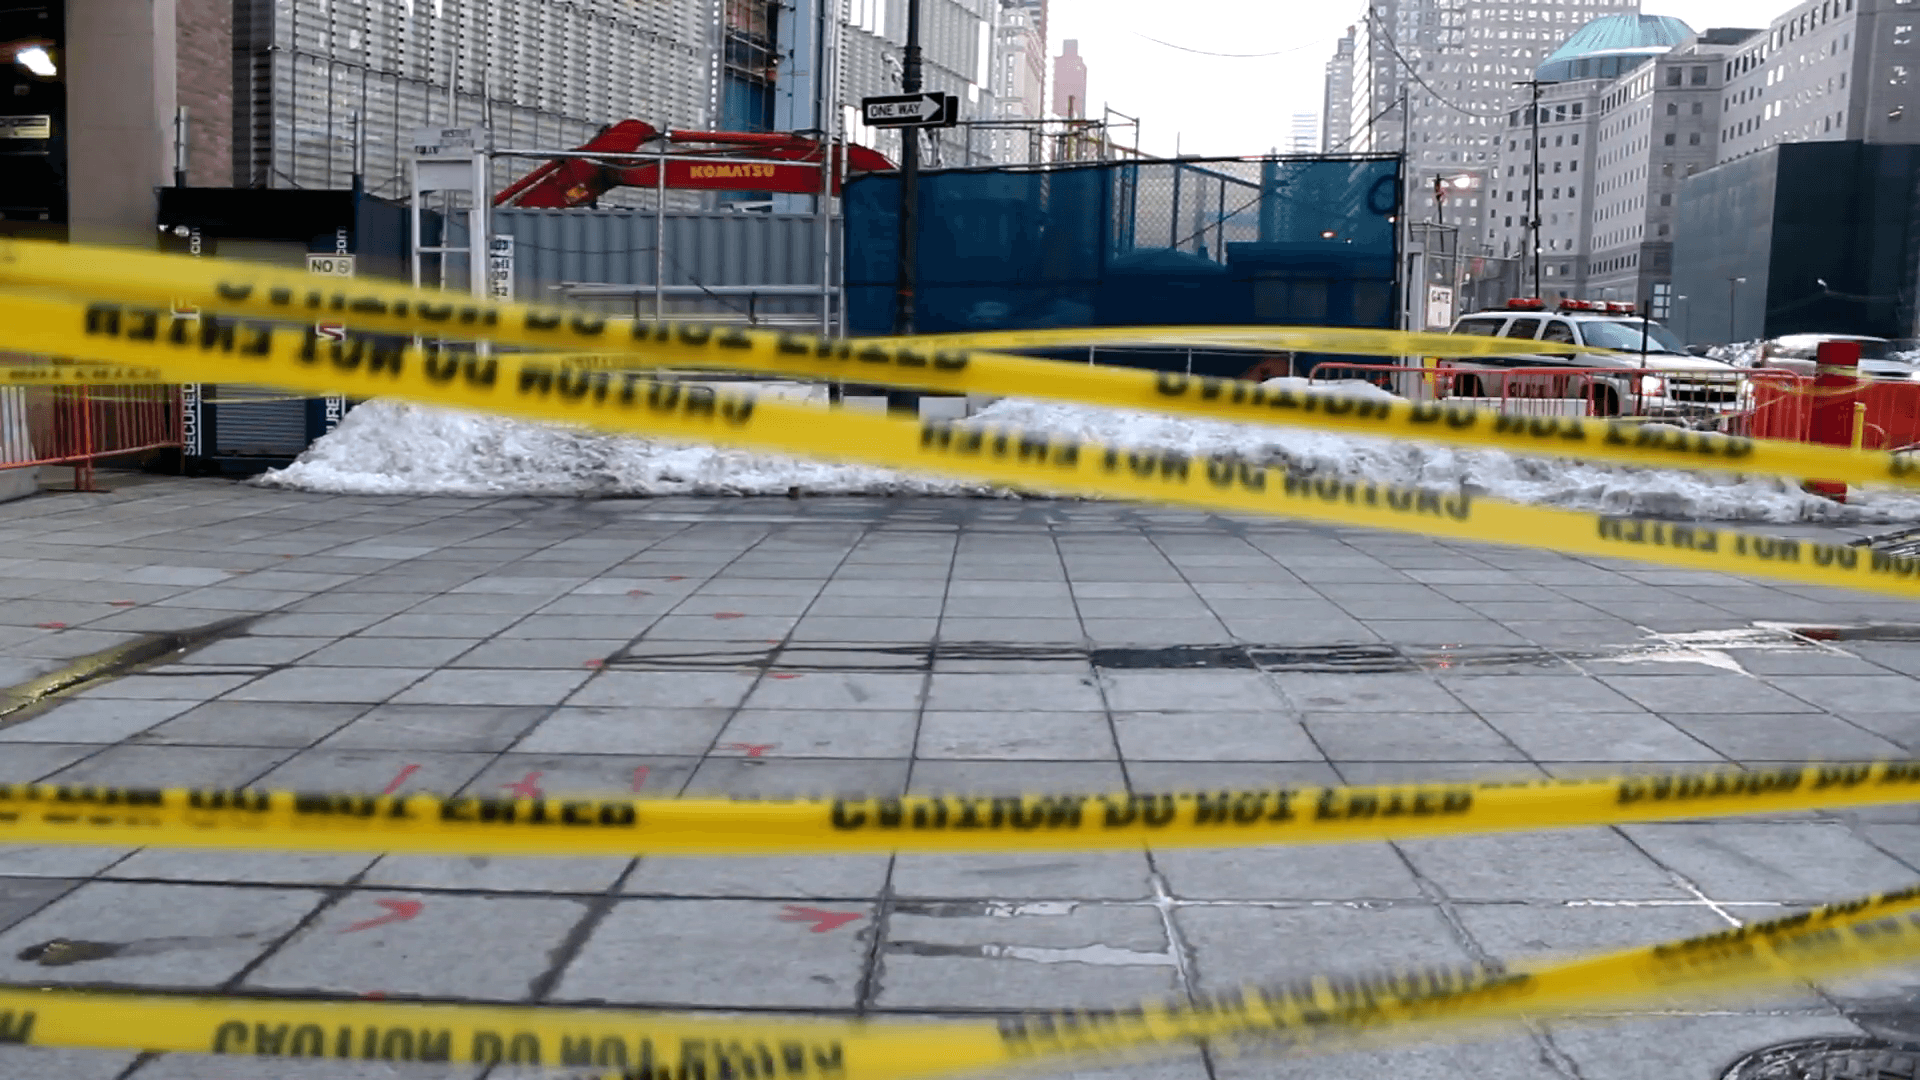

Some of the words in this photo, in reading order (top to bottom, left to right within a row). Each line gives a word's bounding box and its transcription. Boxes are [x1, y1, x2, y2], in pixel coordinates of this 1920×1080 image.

[870, 104, 894, 117] ONE
[898, 103, 920, 115] WAY
[690, 164, 775, 178] KOMATSU
[311, 259, 333, 273] NO
